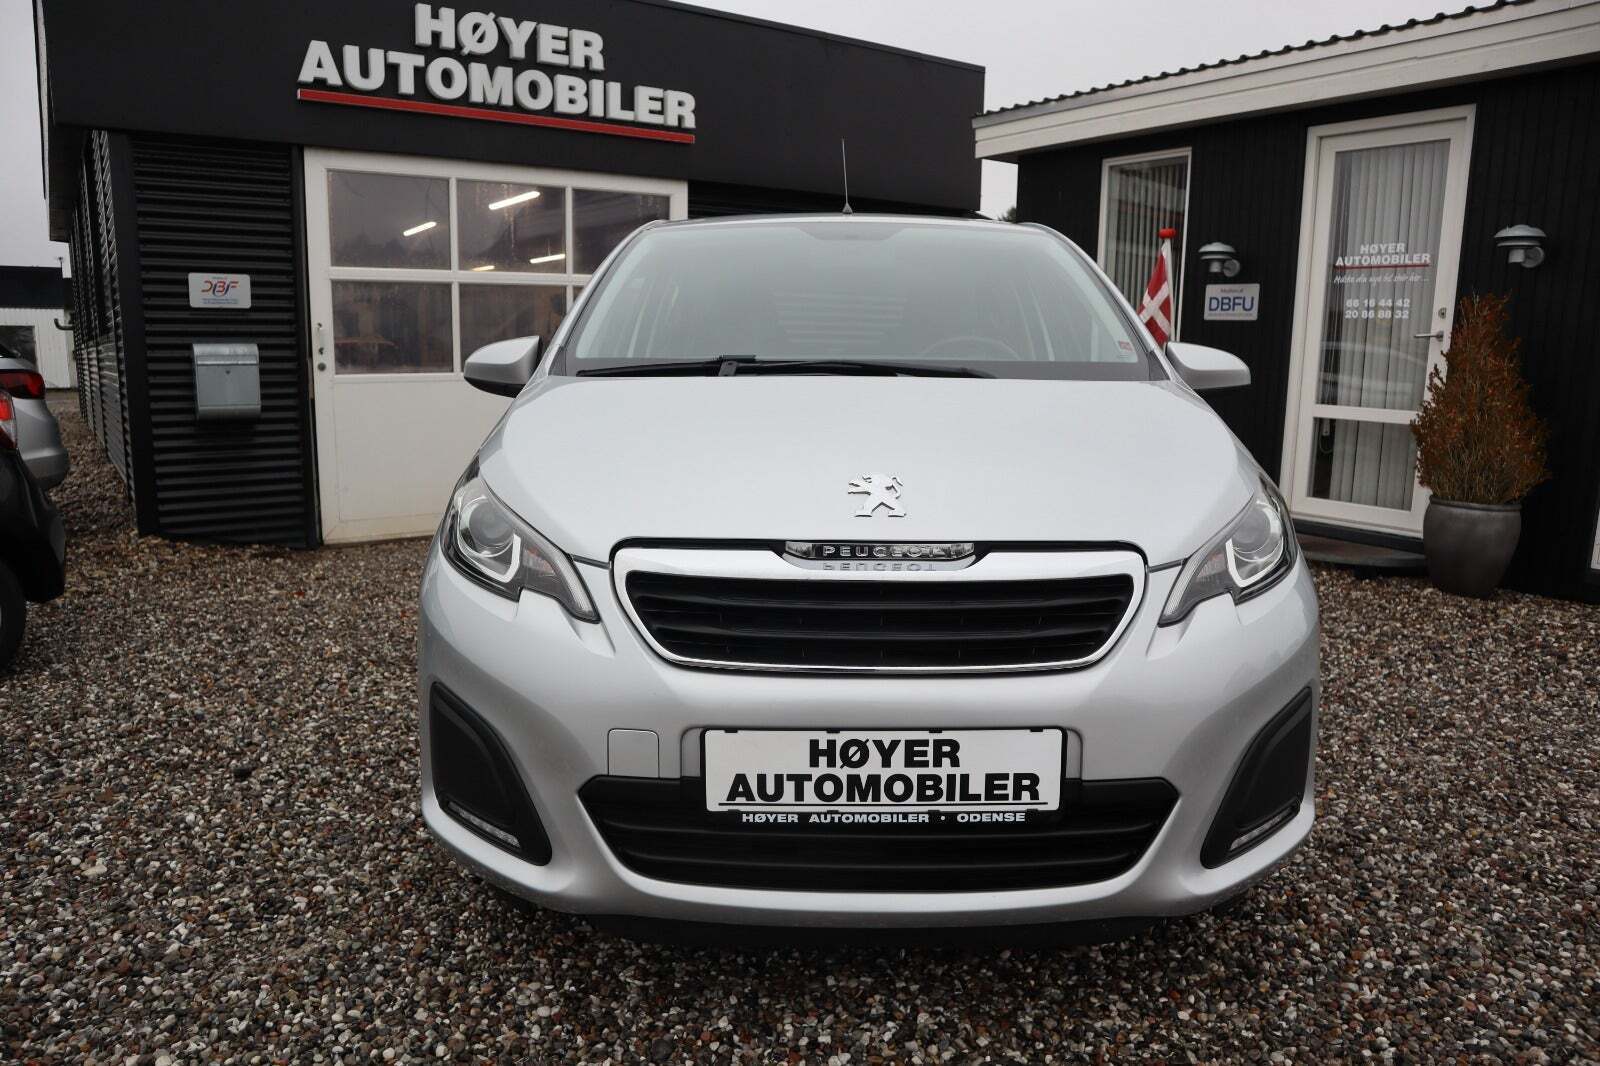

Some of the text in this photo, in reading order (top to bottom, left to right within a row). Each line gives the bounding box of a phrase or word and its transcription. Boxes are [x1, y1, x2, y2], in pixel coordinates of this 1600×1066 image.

[414, 2, 605, 71] HØYER
[297, 39, 696, 129] AUTOMOBILER
[1360, 242, 1405, 255] HØYER
[1335, 253, 1431, 266] AUTOMOBILER
[1208, 296, 1254, 312] DBFU
[1378, 298, 1393, 308] 44
[1395, 298, 1411, 308] 42
[1344, 309, 1359, 319] 20
[1394, 309, 1409, 319] 32
[822, 545, 936, 557] PEUGEOT
[808, 738, 961, 769] HØYER
[726, 773, 1040, 803] AUTOMOBILER
[742, 812, 1026, 824] HØYER AUTOMOBILER ODENSE
